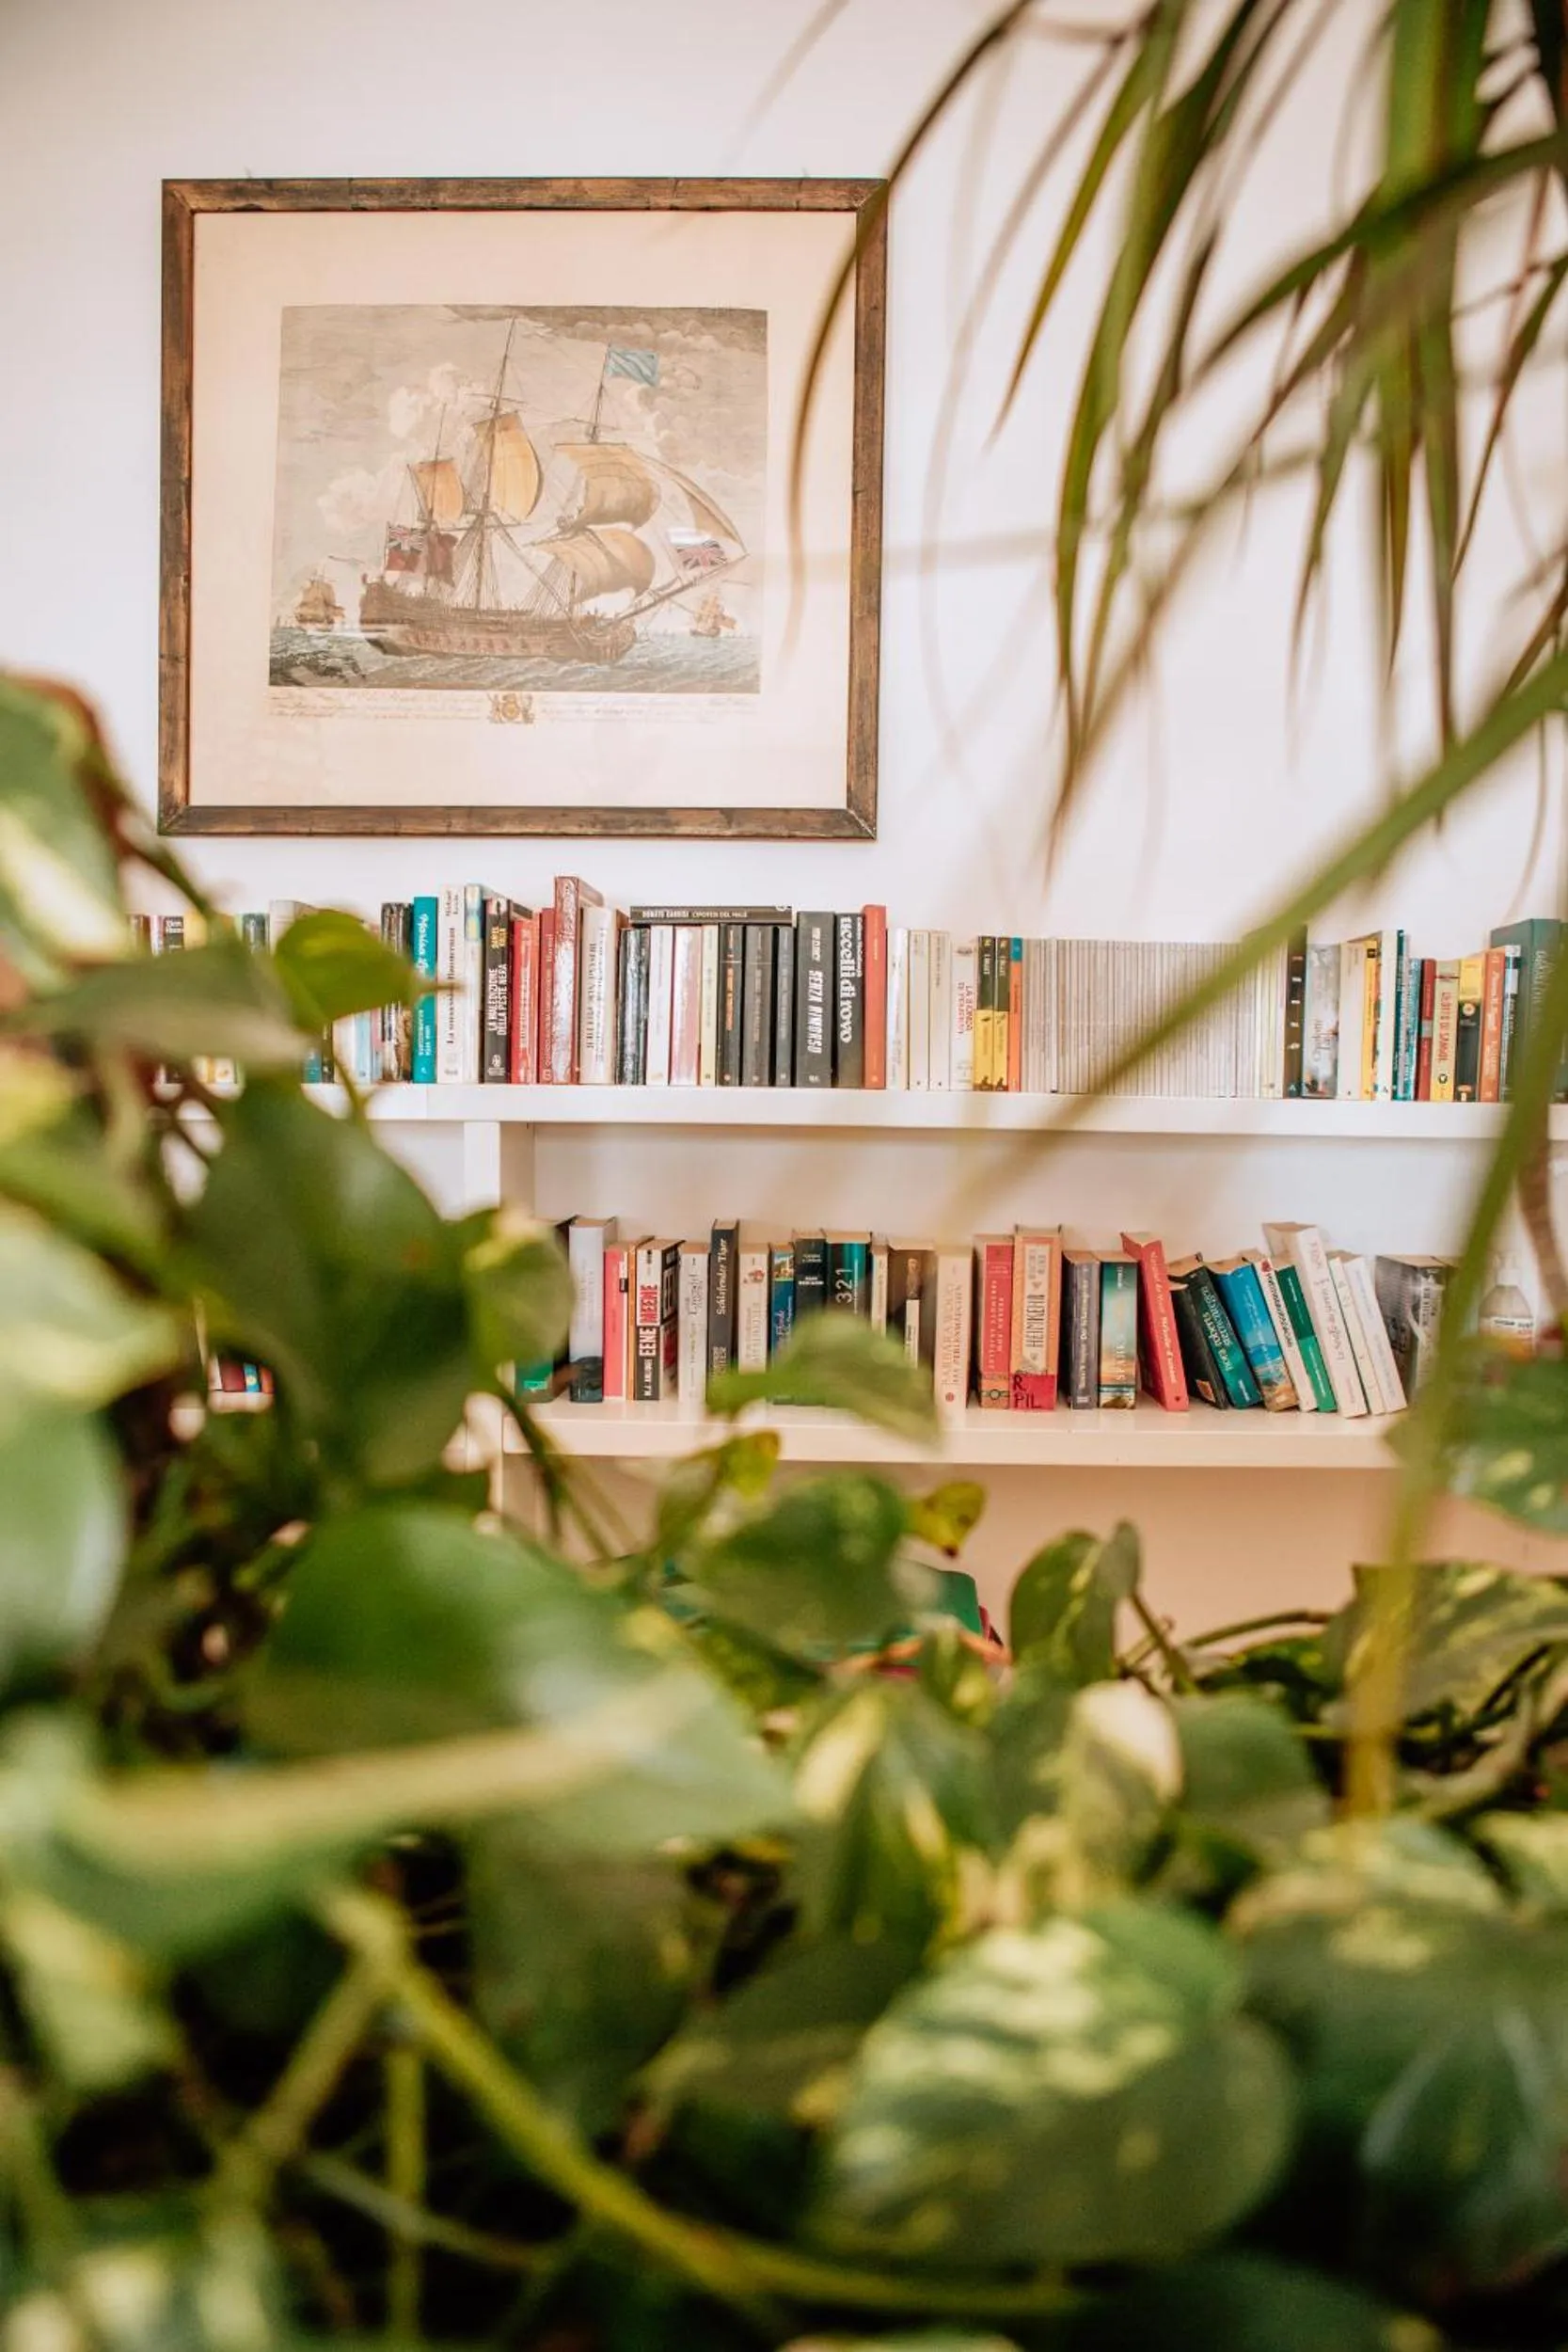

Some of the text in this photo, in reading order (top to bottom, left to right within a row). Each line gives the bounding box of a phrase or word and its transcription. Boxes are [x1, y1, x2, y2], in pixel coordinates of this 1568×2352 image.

[488, 967, 498, 1031] LA MALEDIZIONE
[498, 962, 507, 1035] DELLA PESTE NERA
[807, 970, 823, 1055] SENZA RIMORSO
[839, 916, 856, 1043] uccelli di rovo
[716, 1238, 727, 1315] Schlafender Tiger
[639, 1284, 657, 1357] EENE MEENE
[1026, 1294, 1045, 1348] HEIMKEHR
[1202, 1311, 1222, 1346] roberts
[1015, 1392, 1041, 1408] PIL
